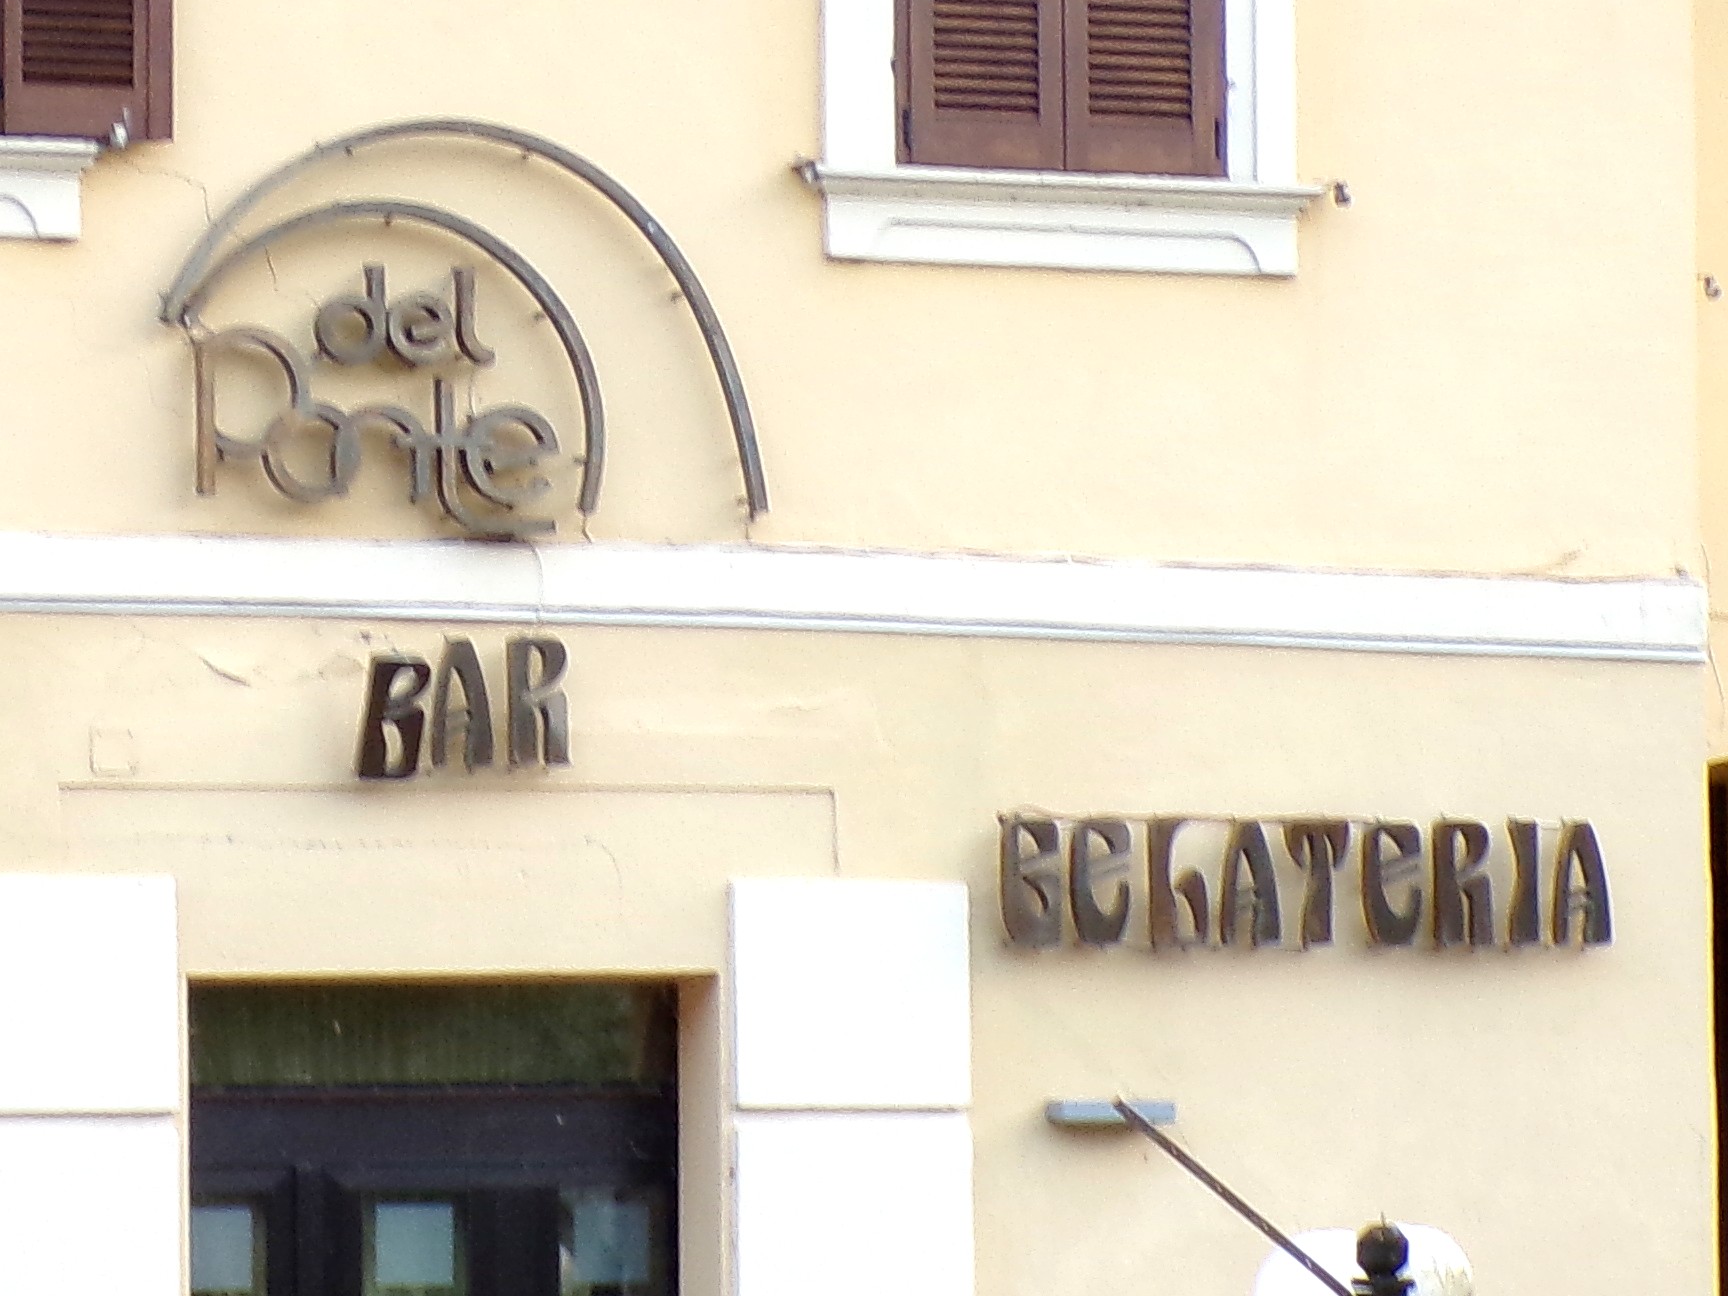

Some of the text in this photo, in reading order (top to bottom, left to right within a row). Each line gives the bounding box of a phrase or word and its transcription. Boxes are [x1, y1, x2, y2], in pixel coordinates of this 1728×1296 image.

[314, 262, 496, 368] del
[189, 325, 561, 536] Ponte
[355, 633, 571, 780] BAR
[997, 814, 1615, 950] GELATERIA
